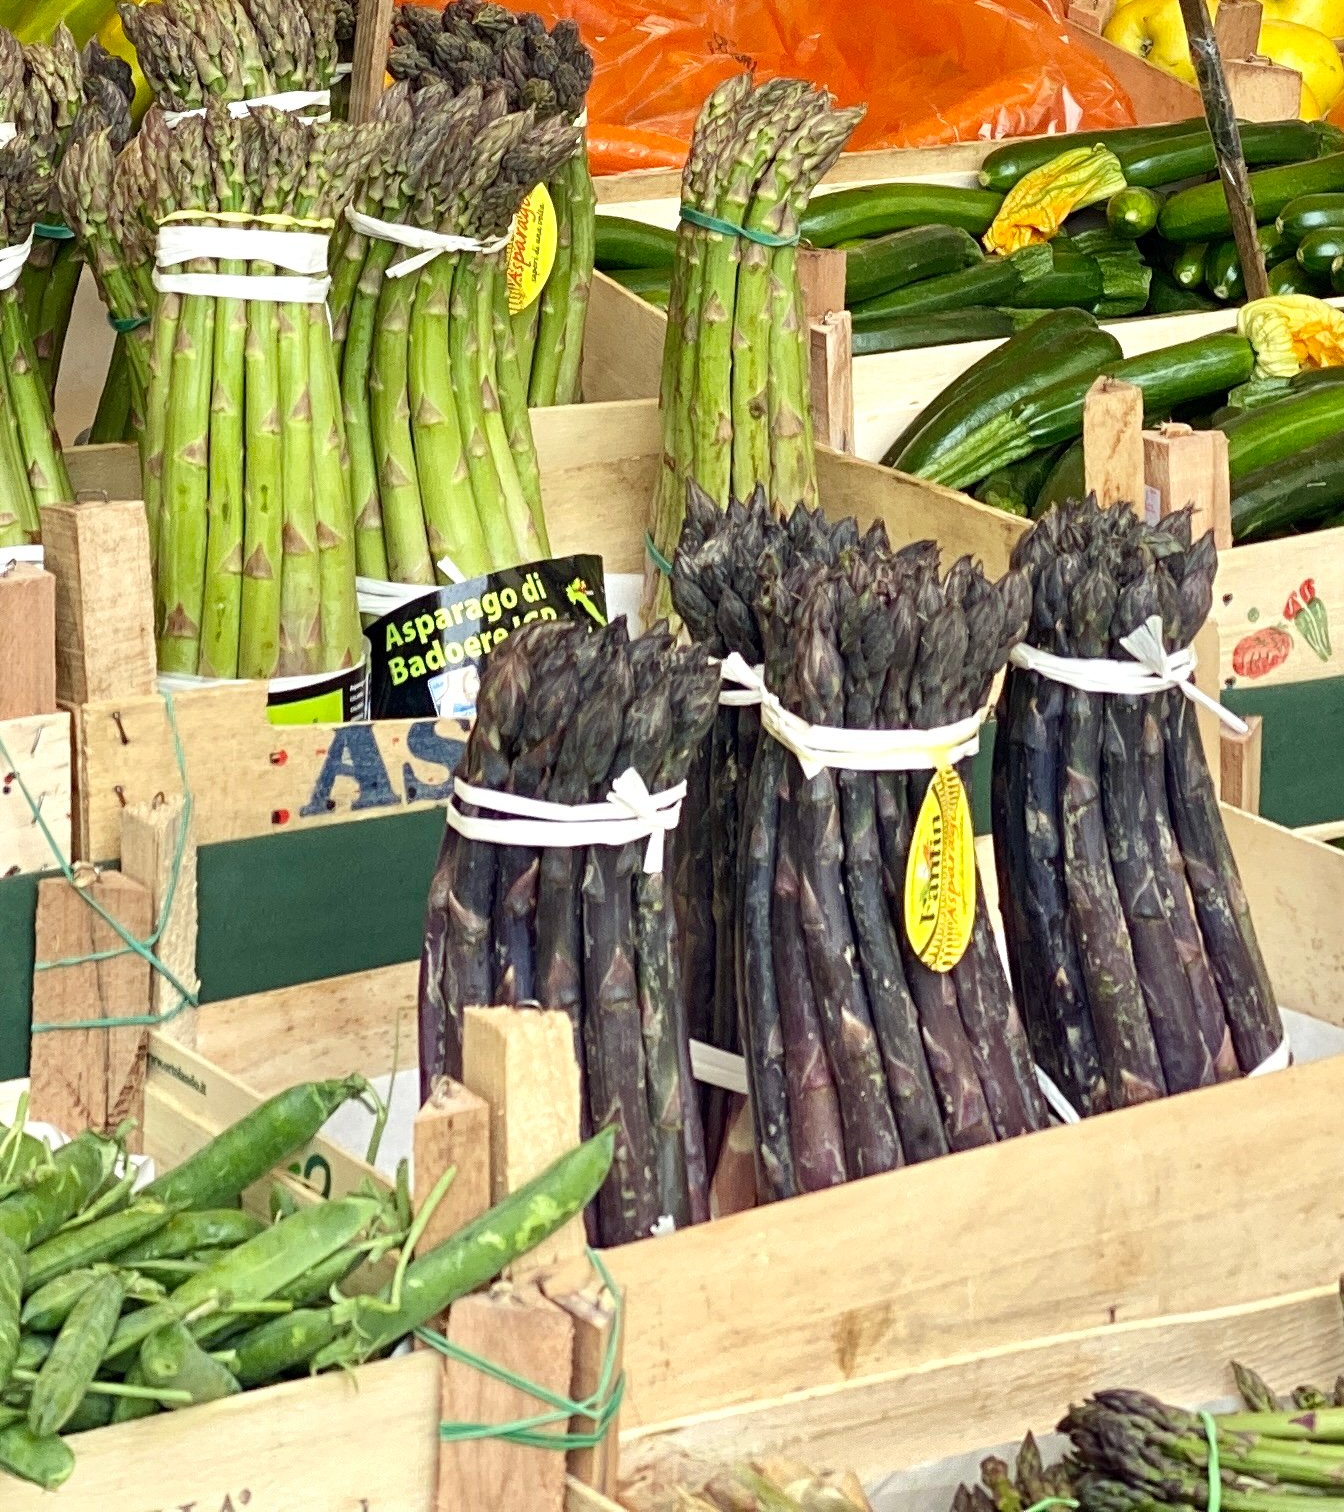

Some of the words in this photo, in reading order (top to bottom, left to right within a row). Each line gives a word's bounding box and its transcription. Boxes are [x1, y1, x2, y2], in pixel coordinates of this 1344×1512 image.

[386, 586, 519, 653] Asparago
[522, 572, 547, 609] di
[387, 628, 509, 687] Badoere
